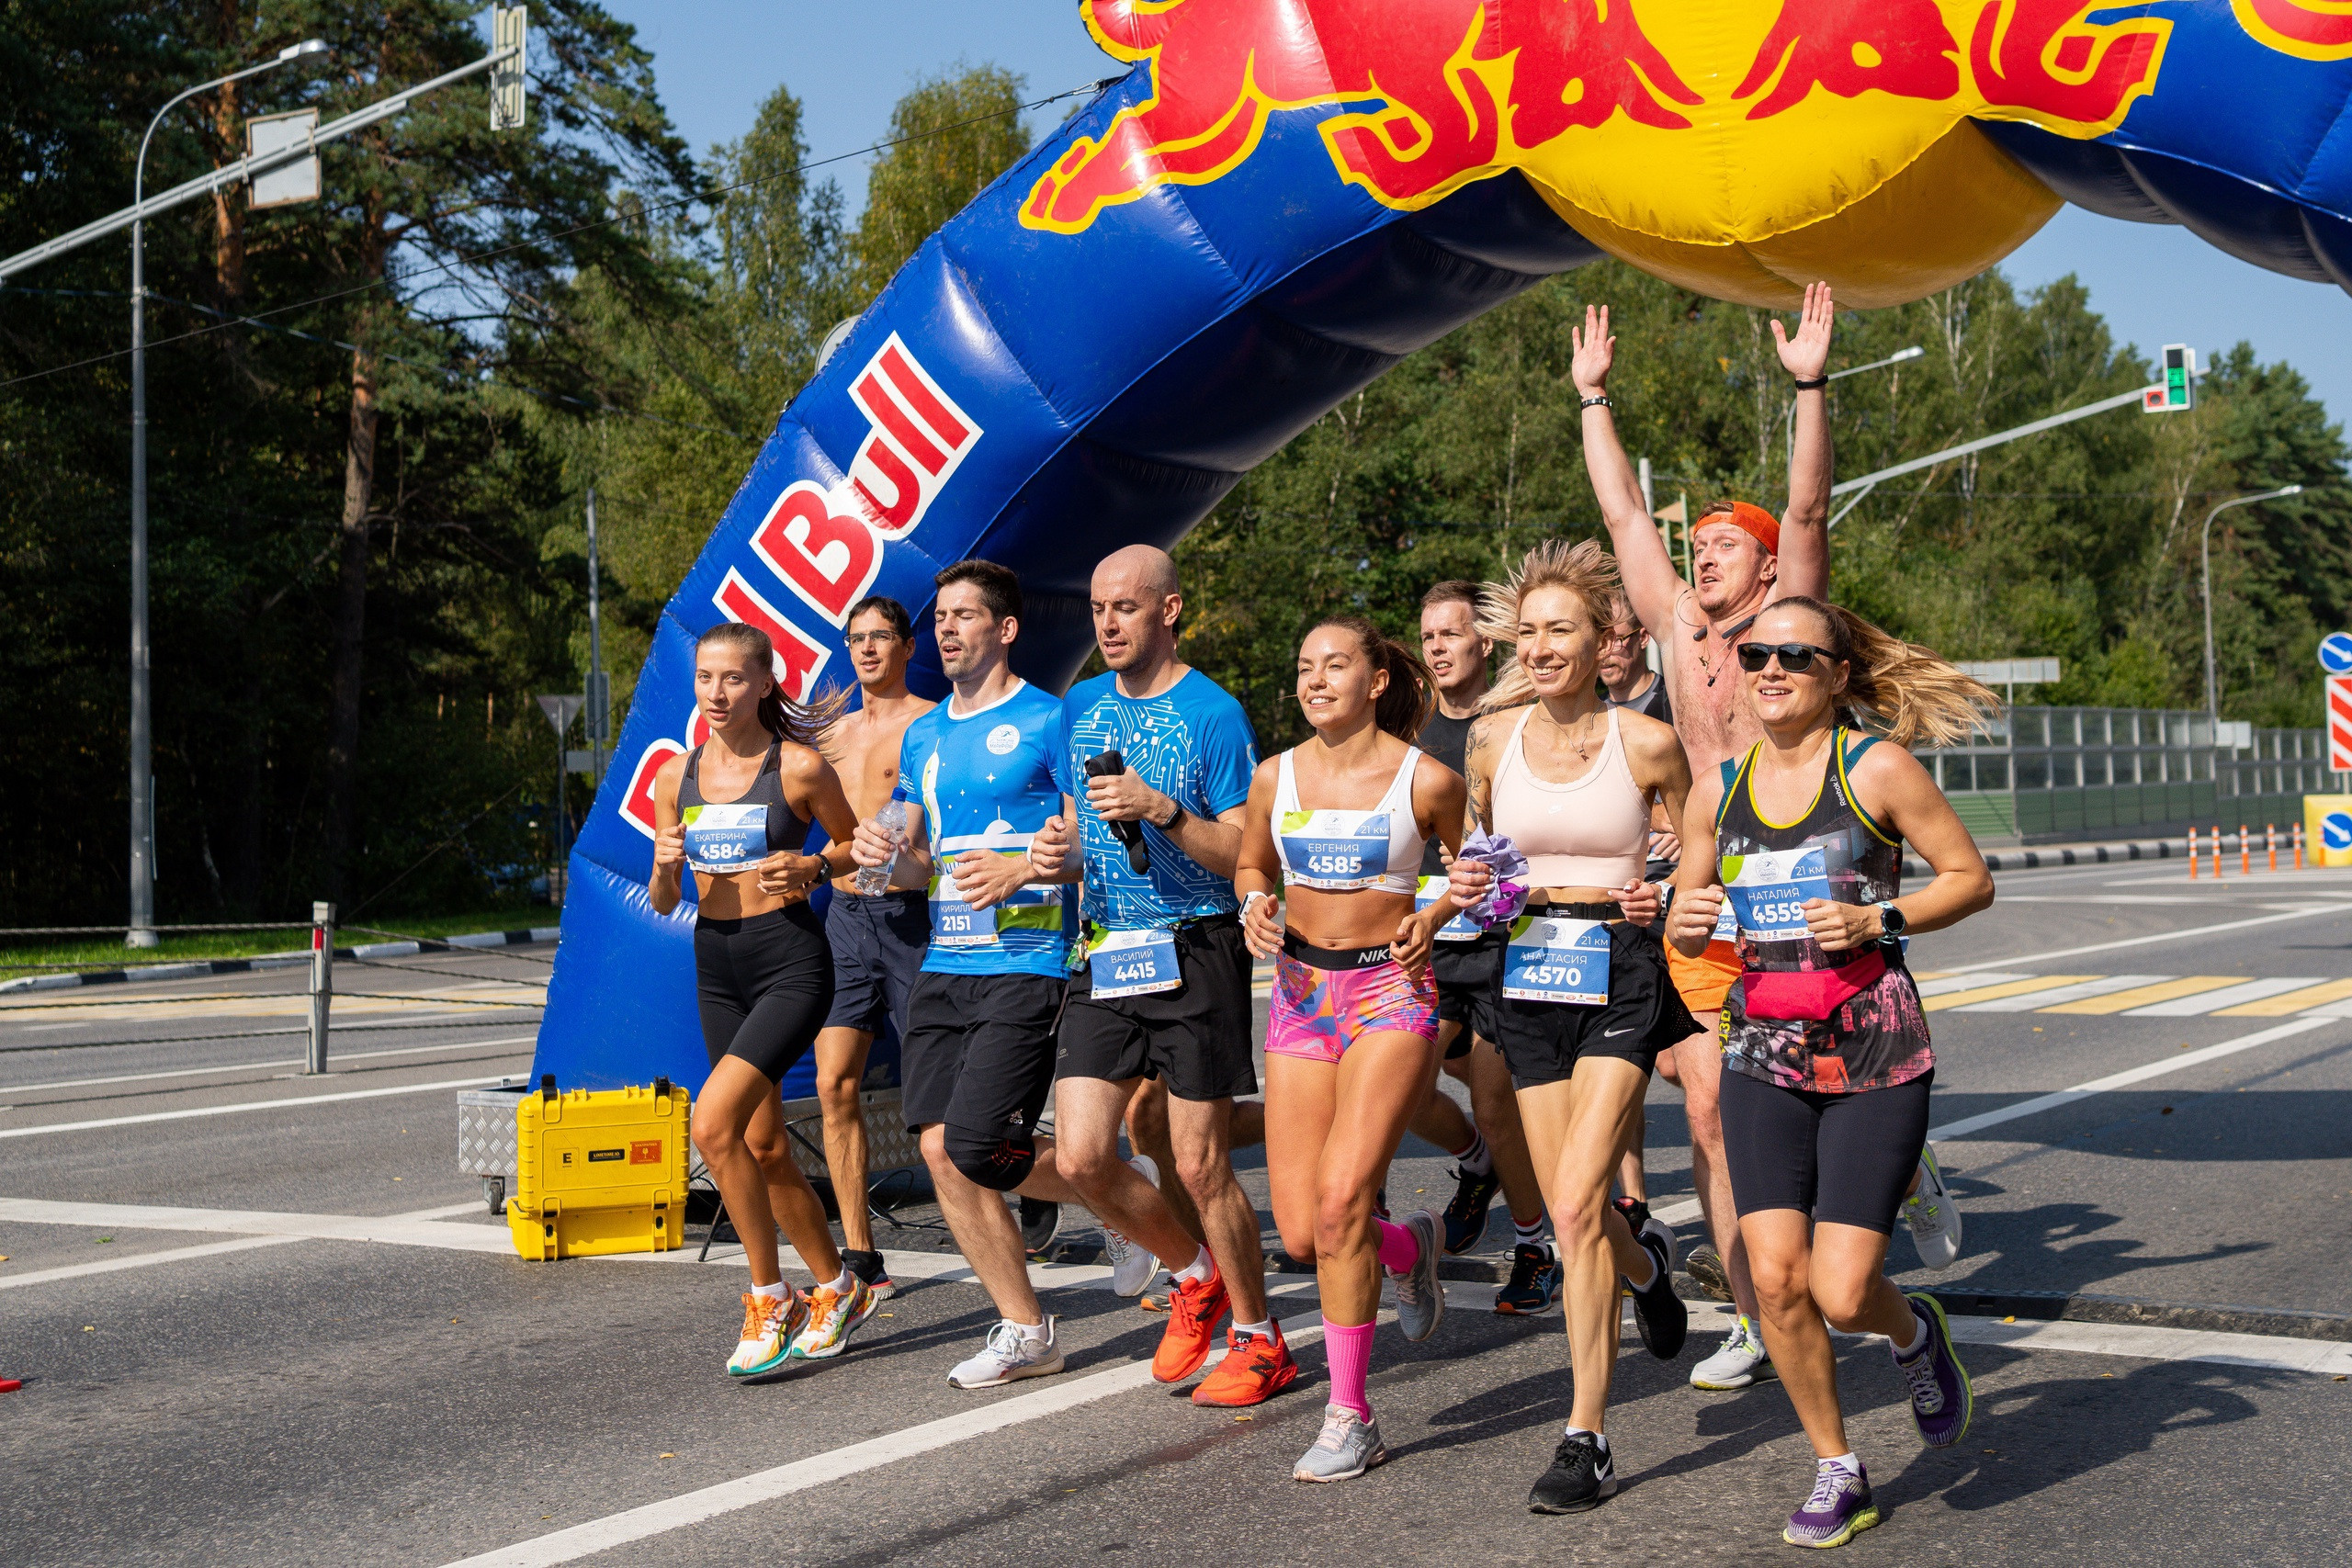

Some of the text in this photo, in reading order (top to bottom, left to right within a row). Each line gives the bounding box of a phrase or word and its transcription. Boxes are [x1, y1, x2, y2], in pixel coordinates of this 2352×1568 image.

[752, 336, 978, 625] Bull
[1833, 781, 1848, 807] Reebok
[695, 832, 748, 842] ЕКАТЕРИНА
[1361, 825, 1370, 834] 21
[699, 842, 747, 860] 4584
[1308, 842, 1360, 853] ЕВГЕНИЯ
[1307, 855, 1363, 874] 4585
[1795, 866, 1806, 876] 21
[1747, 887, 1800, 902] НАТАЛИЯ
[940, 904, 971, 913] КИРИЛЛ
[1752, 901, 1805, 924] 4559
[942, 915, 971, 931] 2151
[1150, 931, 1159, 941] 21
[1580, 935, 1591, 945] 21
[1110, 948, 1154, 964] ВАСИЛИЙ
[1519, 951, 1588, 965] АНАСТАСИЯ
[1114, 961, 1157, 982] 4415
[1522, 965, 1582, 987] 4570
[562, 1152, 572, 1164] E
